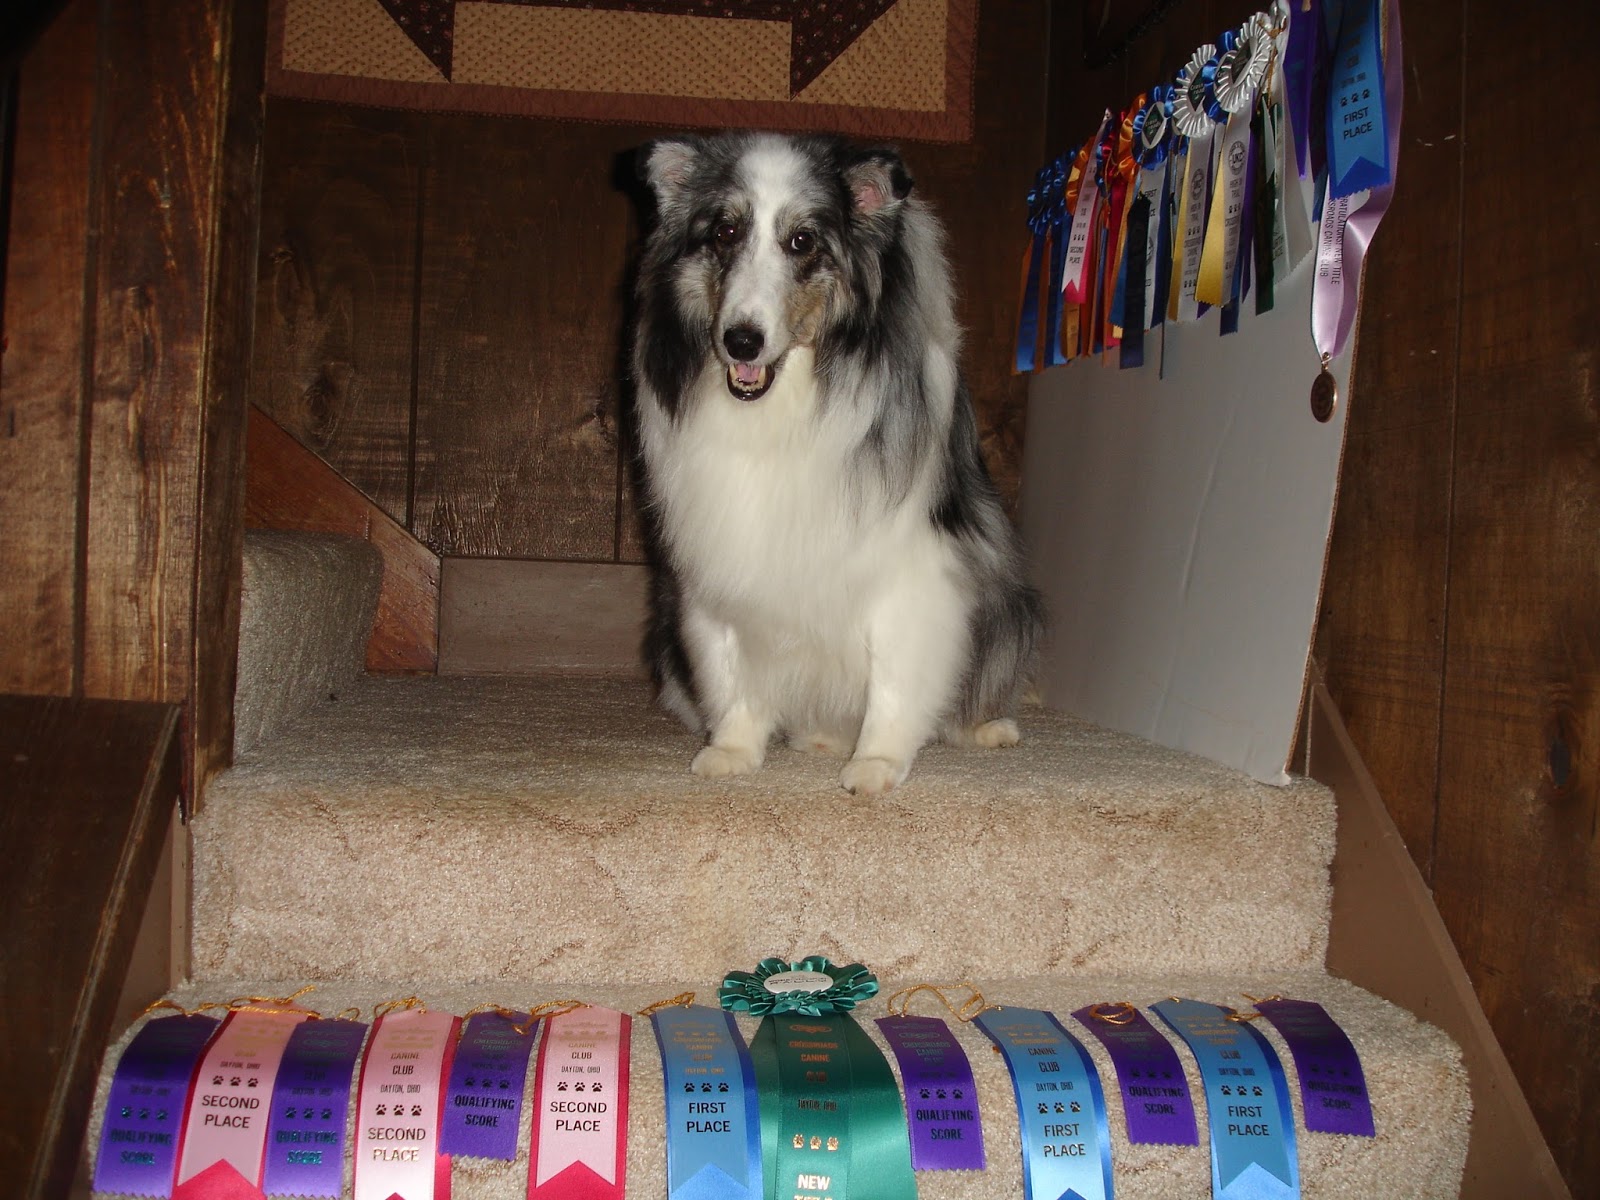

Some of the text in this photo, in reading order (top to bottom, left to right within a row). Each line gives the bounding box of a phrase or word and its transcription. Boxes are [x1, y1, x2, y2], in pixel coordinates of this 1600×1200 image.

[1343, 106, 1369, 125] FIRST
[1343, 121, 1373, 139] PLACE
[1334, 248, 1343, 263] NEW
[1320, 259, 1330, 277] CLUB
[1331, 267, 1342, 285] TITLE
[390, 1051, 420, 1061] CANINE
[571, 1051, 593, 1060] CLUB
[800, 1053, 830, 1063] CANINE
[1028, 1047, 1057, 1056] CANINE
[392, 1064, 414, 1076] CLUB
[587, 1065, 601, 1074] OHIO
[1038, 1061, 1061, 1073] CLUB
[406, 1084, 421, 1094] OHIO
[1128, 1085, 1184, 1099] QUALIFYING
[202, 1095, 260, 1110] SECOND
[454, 1094, 515, 1111] QUALIFYING
[550, 1101, 608, 1114] SECOND
[688, 1102, 727, 1114] FIRST
[1144, 1103, 1176, 1115] SCORE
[1322, 1097, 1352, 1110] SCORE
[916, 1108, 974, 1122] QUALIFYING
[1227, 1105, 1263, 1118] FIRST
[204, 1114, 251, 1129] PLACE
[465, 1113, 499, 1128] SCORE
[555, 1119, 602, 1132] PLACE
[686, 1120, 731, 1133] PLACE
[111, 1129, 172, 1145] QUALIFYING
[367, 1128, 426, 1141] SECOND
[930, 1128, 965, 1141] SCORE
[1043, 1123, 1081, 1138] FIRST
[1227, 1123, 1270, 1137] PLACE
[276, 1130, 338, 1145] QUALIFYING
[287, 1150, 323, 1165] SCORE
[372, 1148, 420, 1162] PLACE
[1043, 1143, 1087, 1158] PLACE
[797, 1174, 831, 1191] NEW
